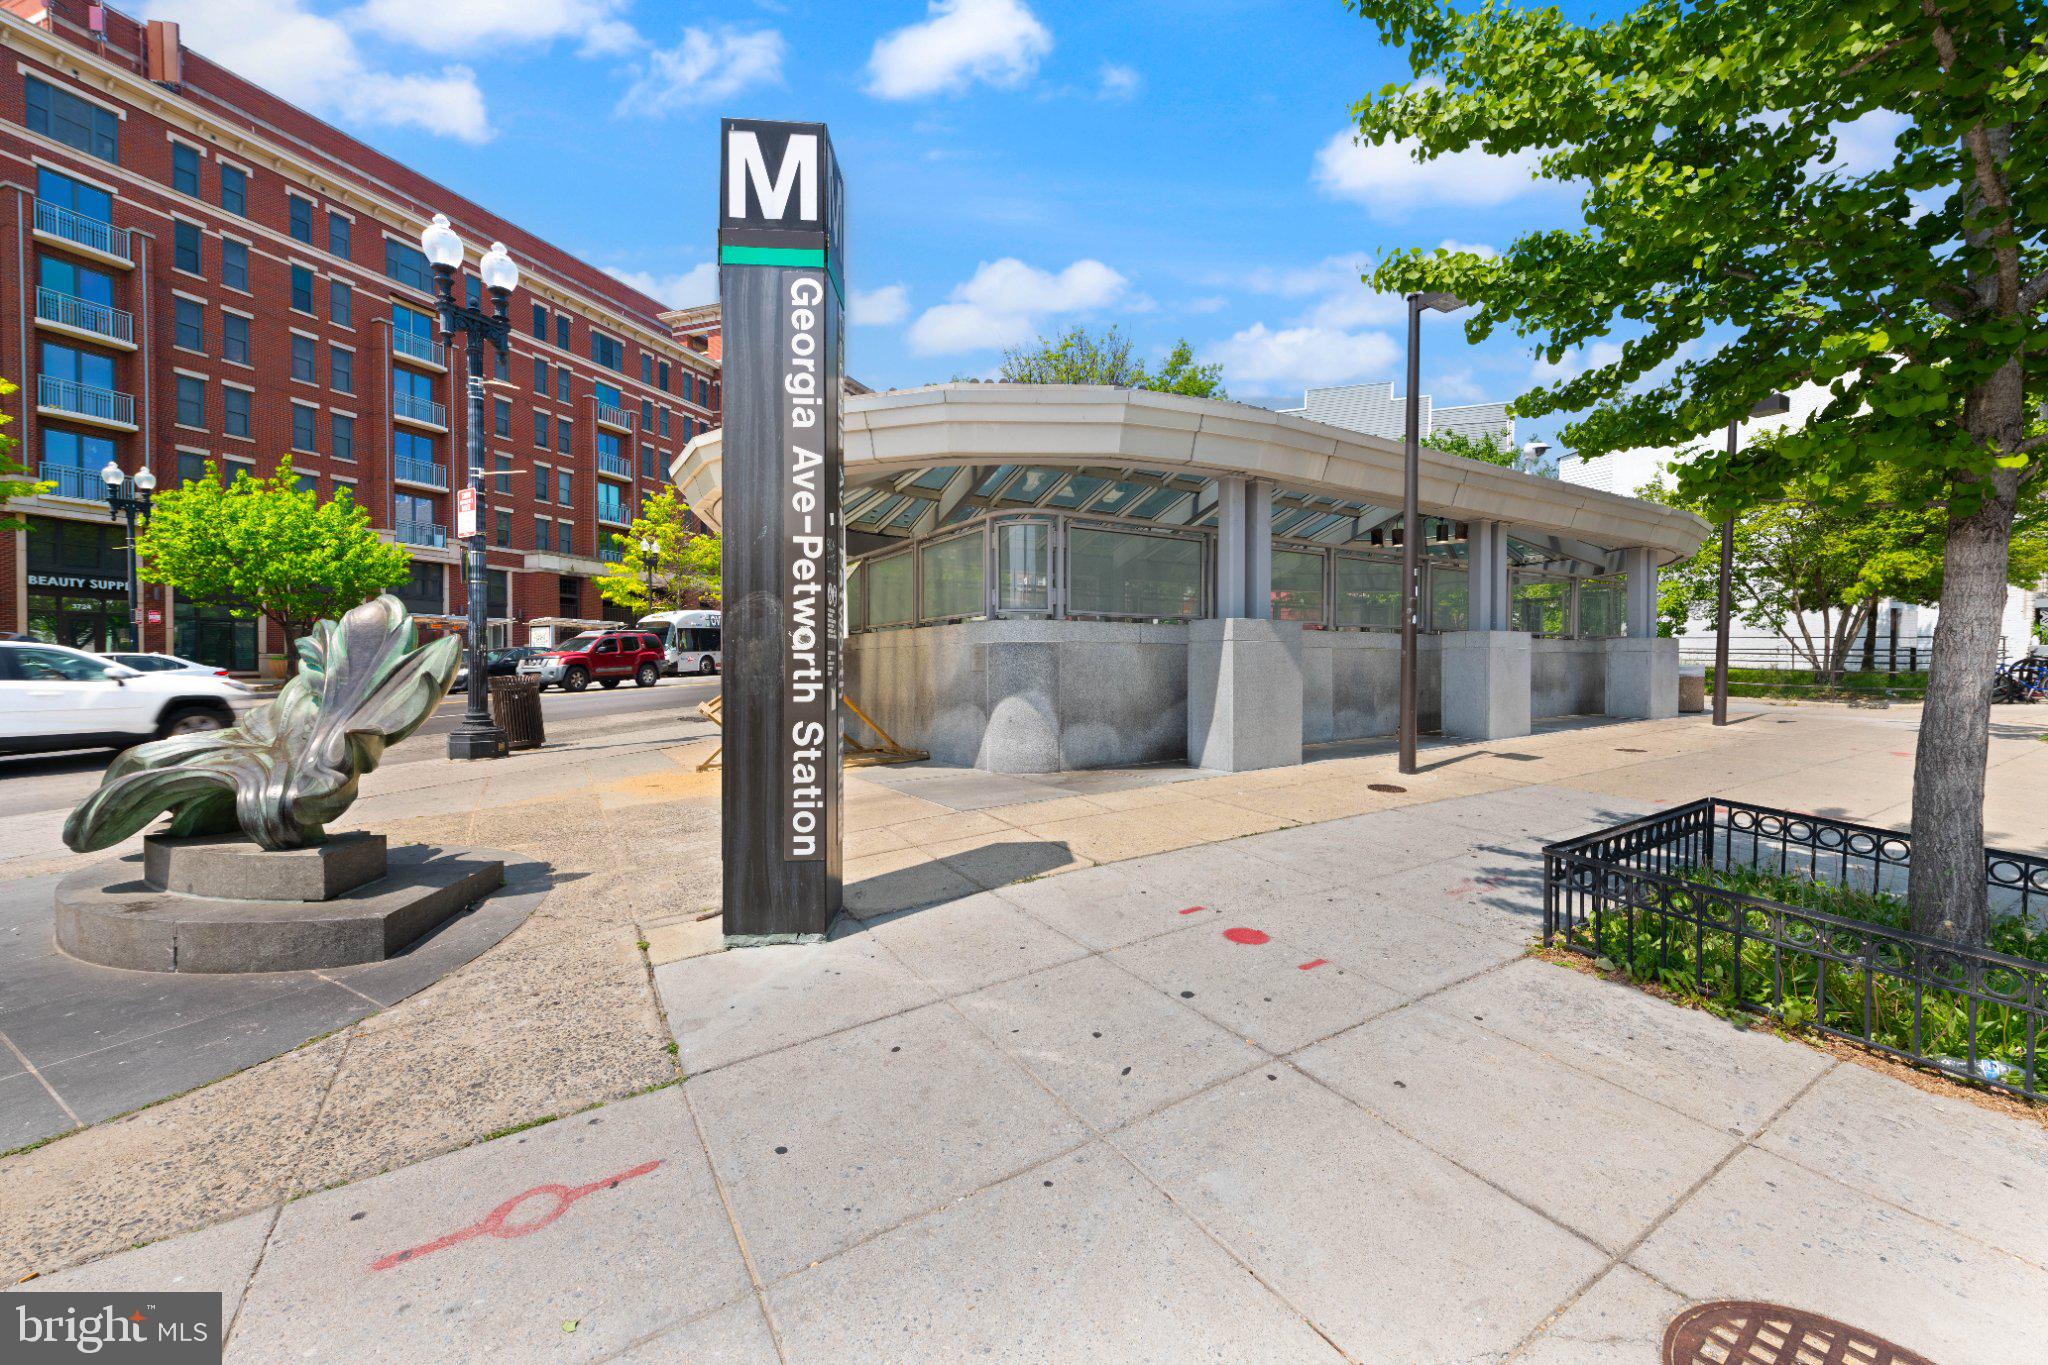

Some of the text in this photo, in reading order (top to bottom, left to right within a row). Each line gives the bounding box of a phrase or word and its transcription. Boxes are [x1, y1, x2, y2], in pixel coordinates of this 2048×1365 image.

[728, 129, 819, 222] M
[28, 575, 129, 591] BEAUTY SUPPL
[784, 277, 825, 857] Georgia Ave-Petworth Station
